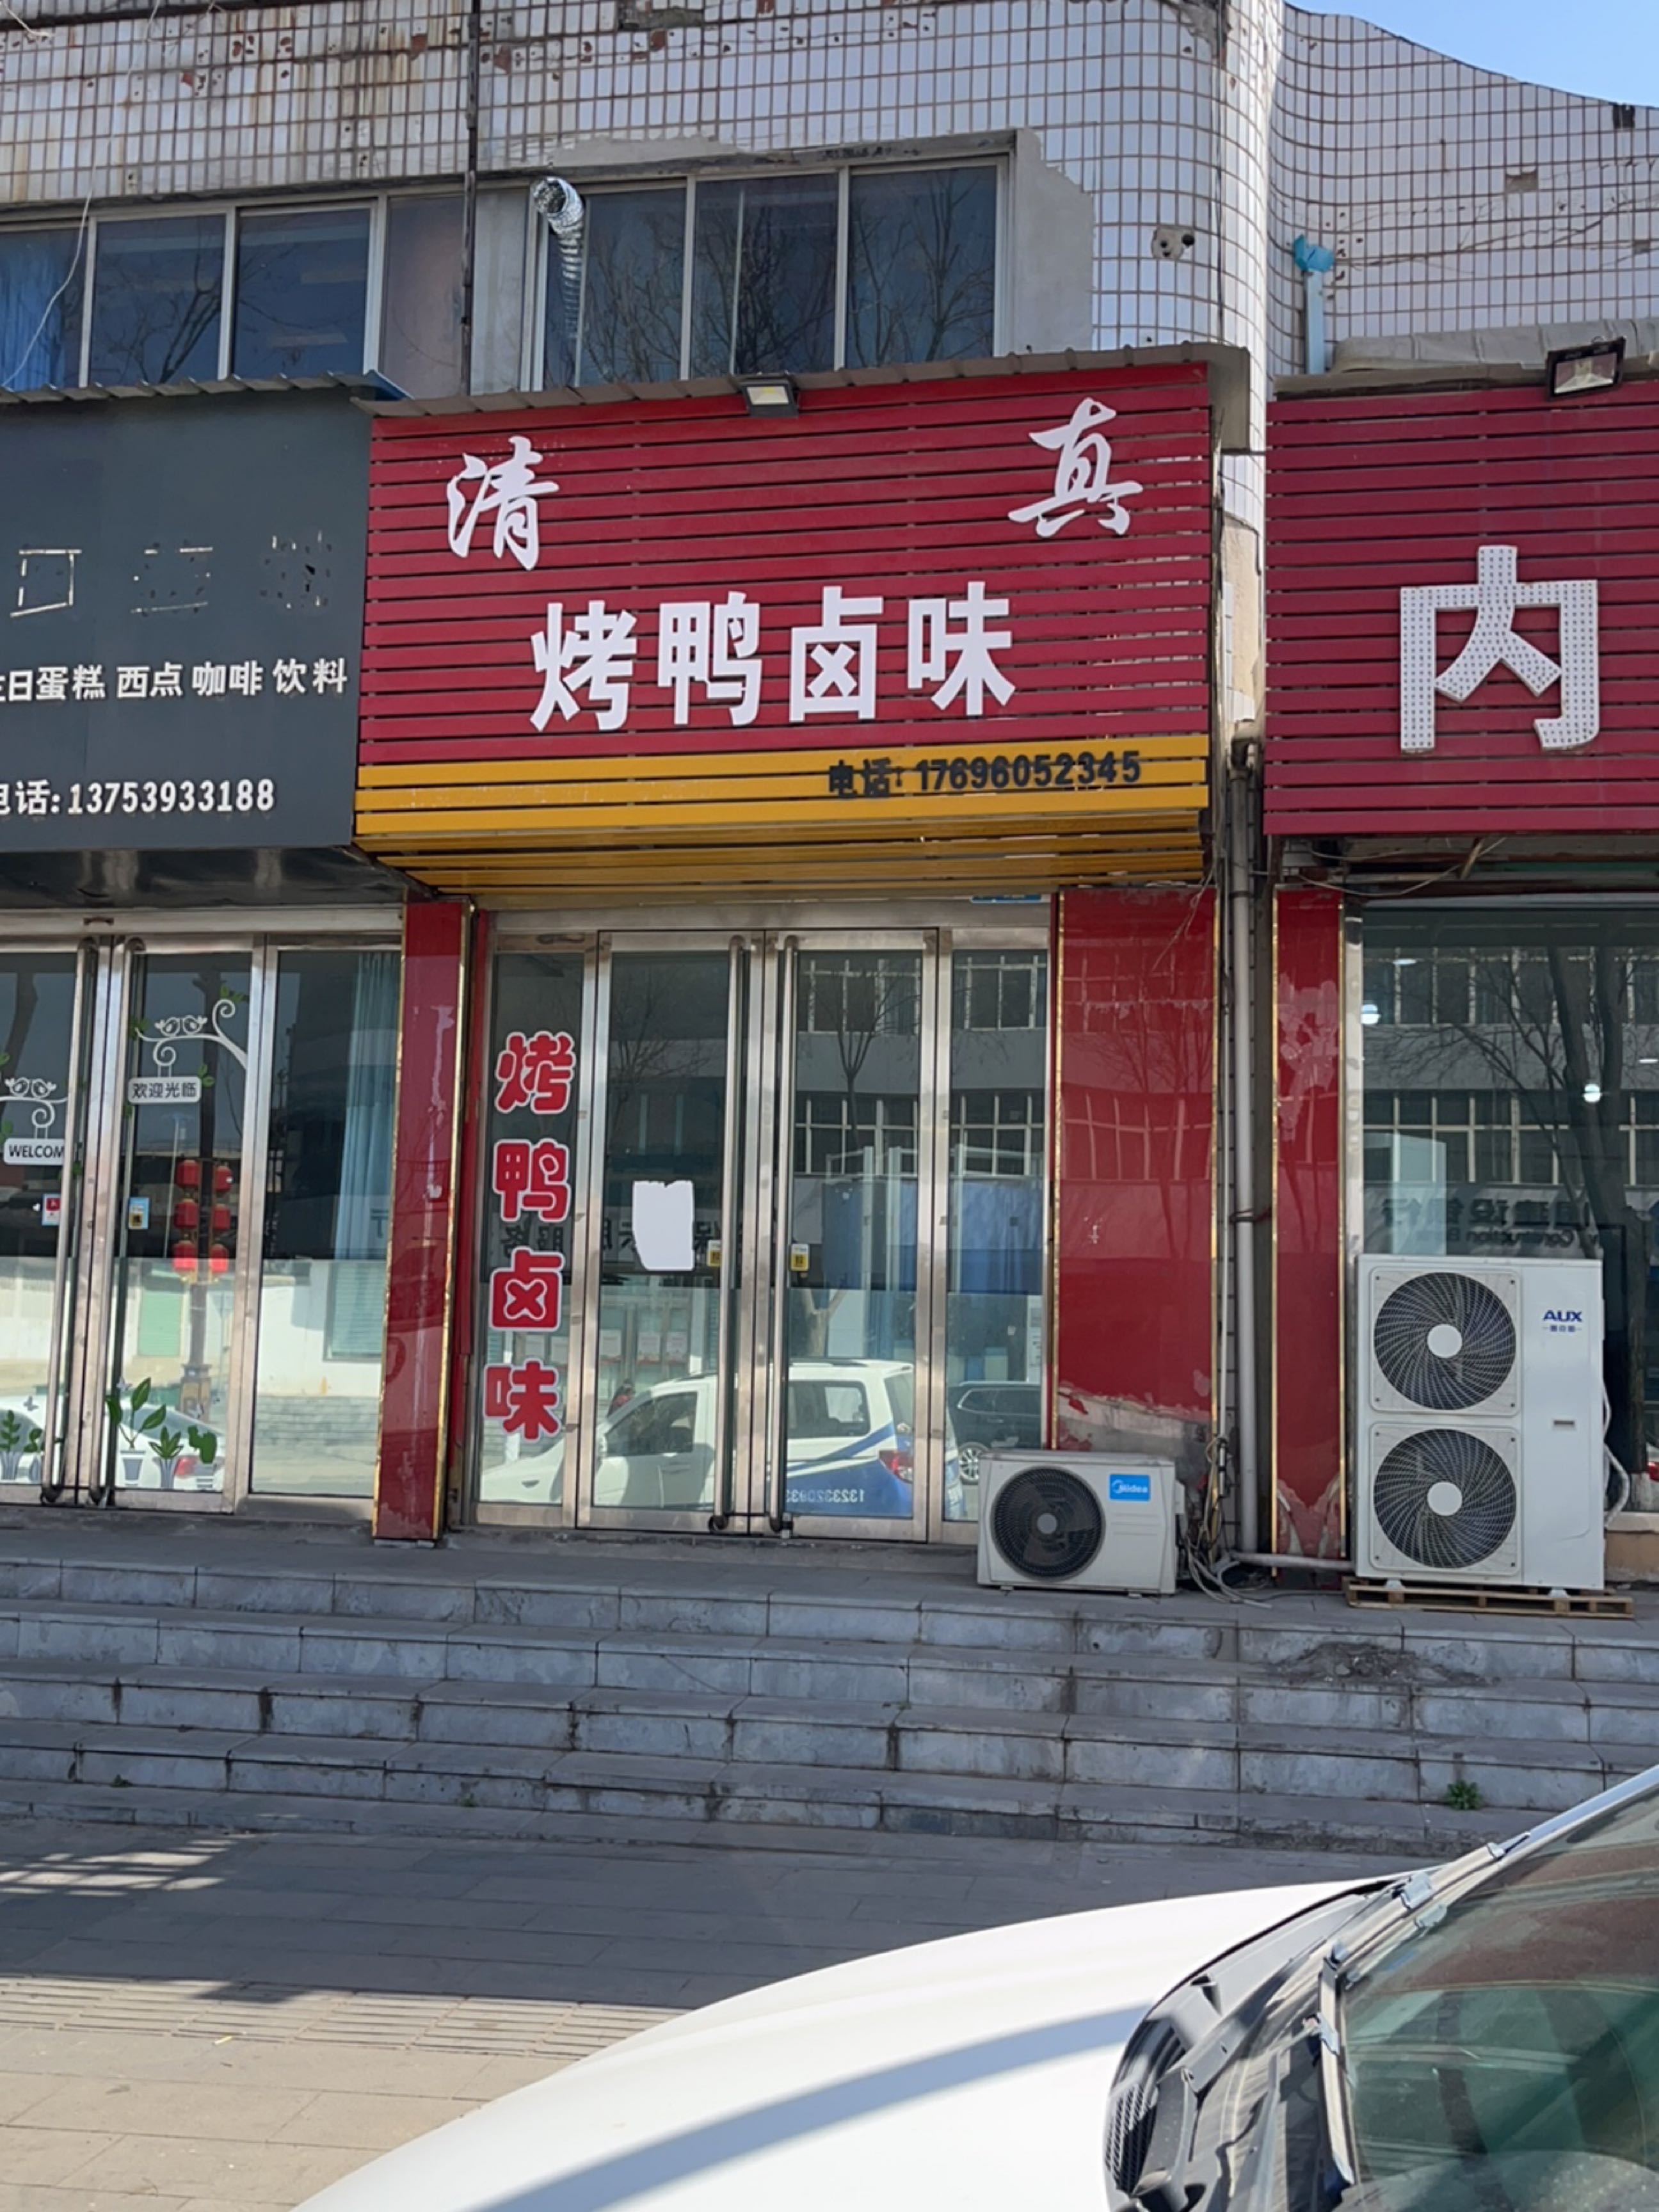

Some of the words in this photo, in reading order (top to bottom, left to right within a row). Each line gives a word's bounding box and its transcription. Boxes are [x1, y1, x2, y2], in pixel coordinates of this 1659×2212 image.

[447, 436, 559, 570] 清
[1007, 397, 1143, 536] 真
[0, 664, 106, 702] 日蛋糕
[116, 661, 183, 698] 西点
[192, 659, 263, 696] 咖啡
[272, 657, 348, 694] 饮料
[530, 581, 1016, 732] 烤鸭卤味
[1400, 544, 1600, 753] 内
[131, 1080, 197, 1099] 欢迎光临
[8, 1144, 65, 1159] WELCOM
[483, 1031, 575, 1442] 烤鸭卤味
[1543, 1310, 1582, 1322] AUX
